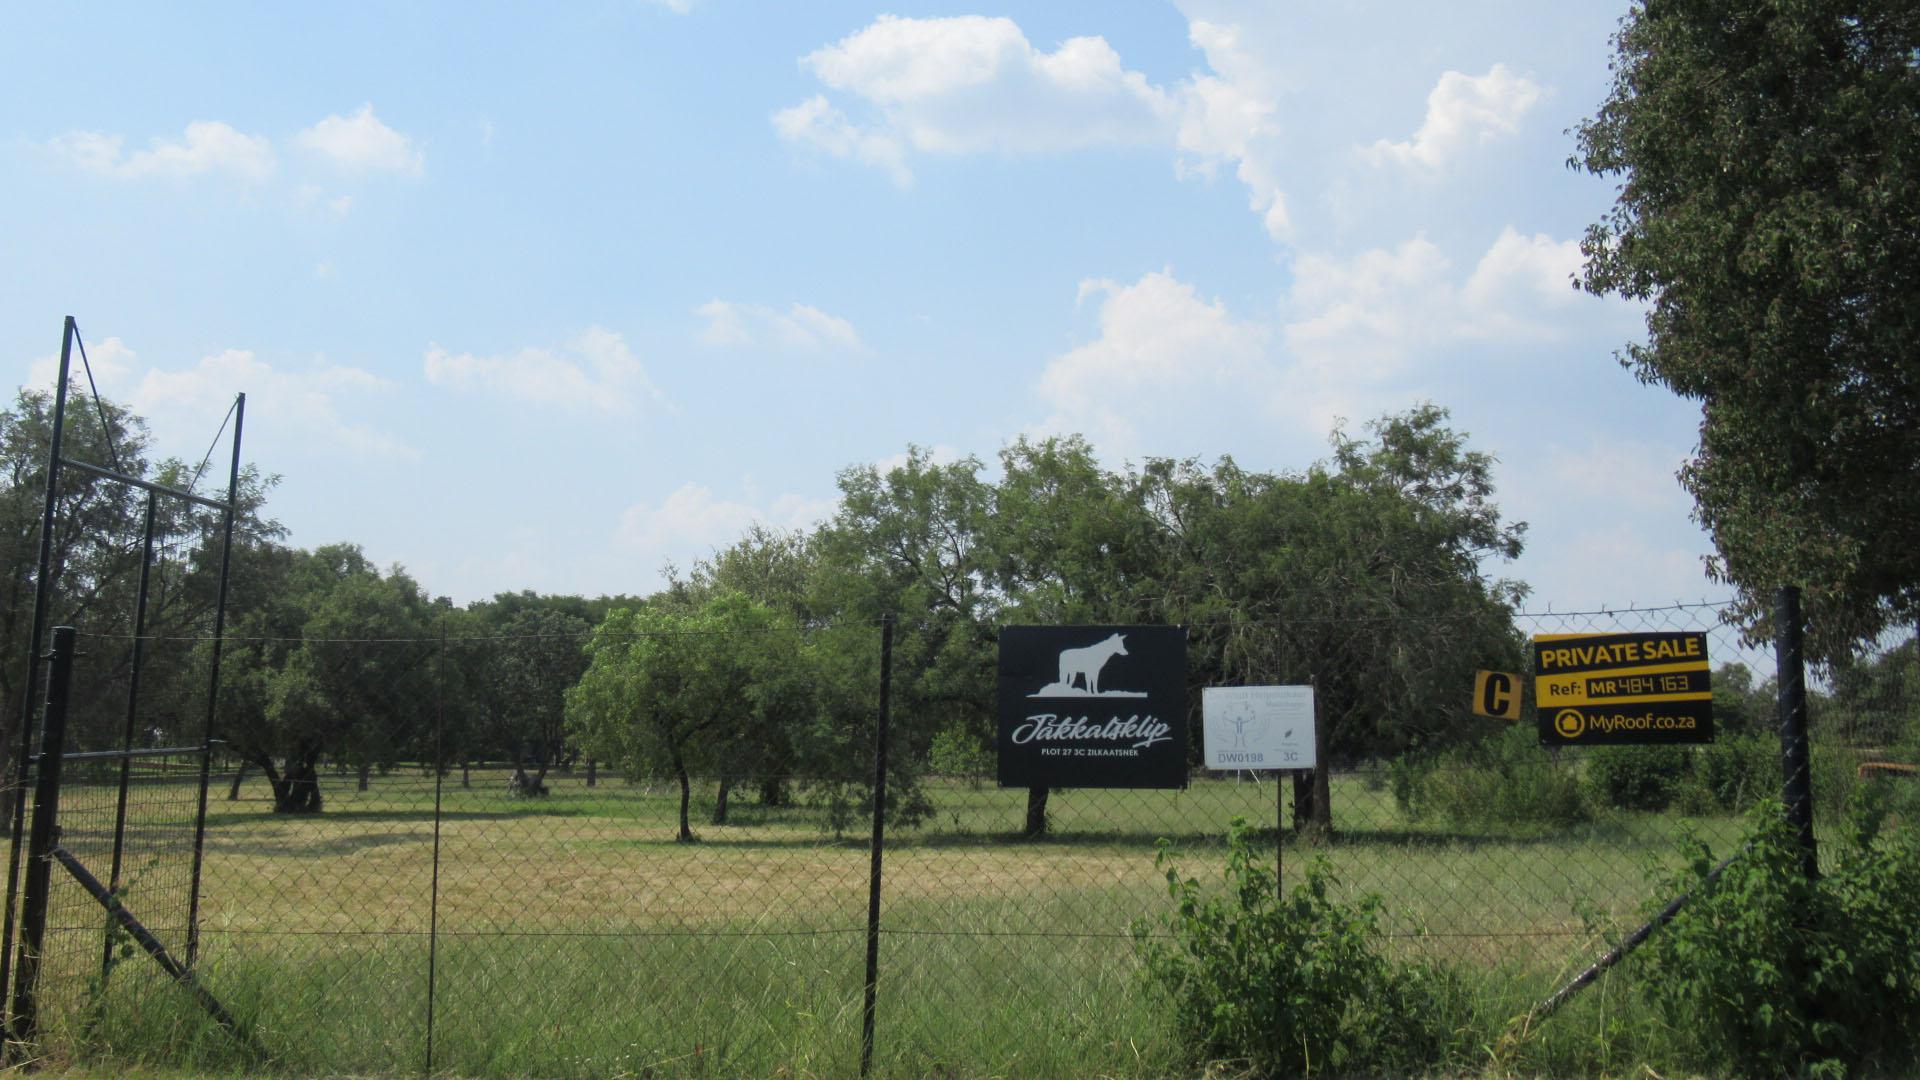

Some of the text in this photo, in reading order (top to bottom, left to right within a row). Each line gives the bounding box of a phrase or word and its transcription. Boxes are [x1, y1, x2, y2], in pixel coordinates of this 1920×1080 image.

[1541, 637, 1701, 669] PRIVATE SALE
[1483, 672, 1511, 716] C
[1550, 683, 1582, 696] Ref:
[1590, 713, 1696, 733] MyRoof.co.za
[1041, 748, 1139, 757] PLOT 27 3C ZILKAATSNEK
[1217, 752, 1299, 764] DW0198 3C
